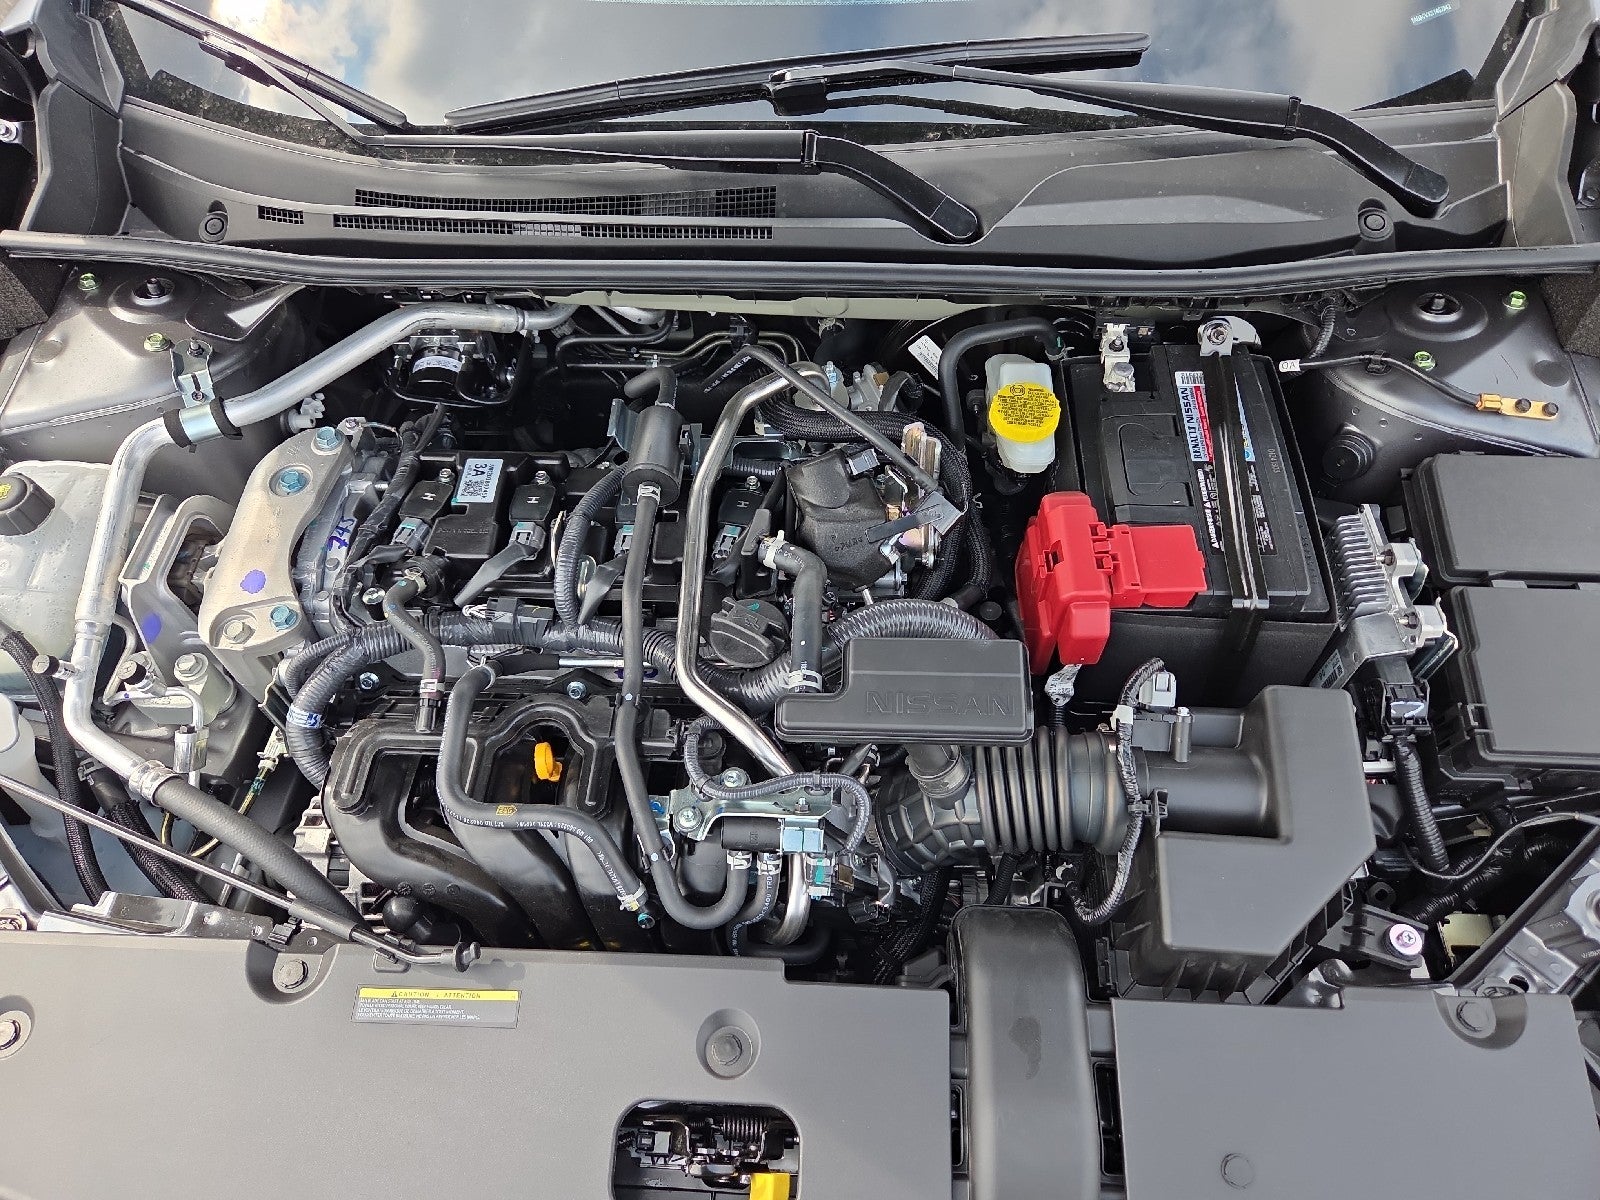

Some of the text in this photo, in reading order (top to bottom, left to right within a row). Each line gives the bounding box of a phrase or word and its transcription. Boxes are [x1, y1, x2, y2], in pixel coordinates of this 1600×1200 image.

[1180, 387, 1195, 423] NISSAN
[1188, 426, 1203, 459] RENAULT
[472, 463, 488, 477] 3A
[866, 691, 1016, 716] NISSAN
